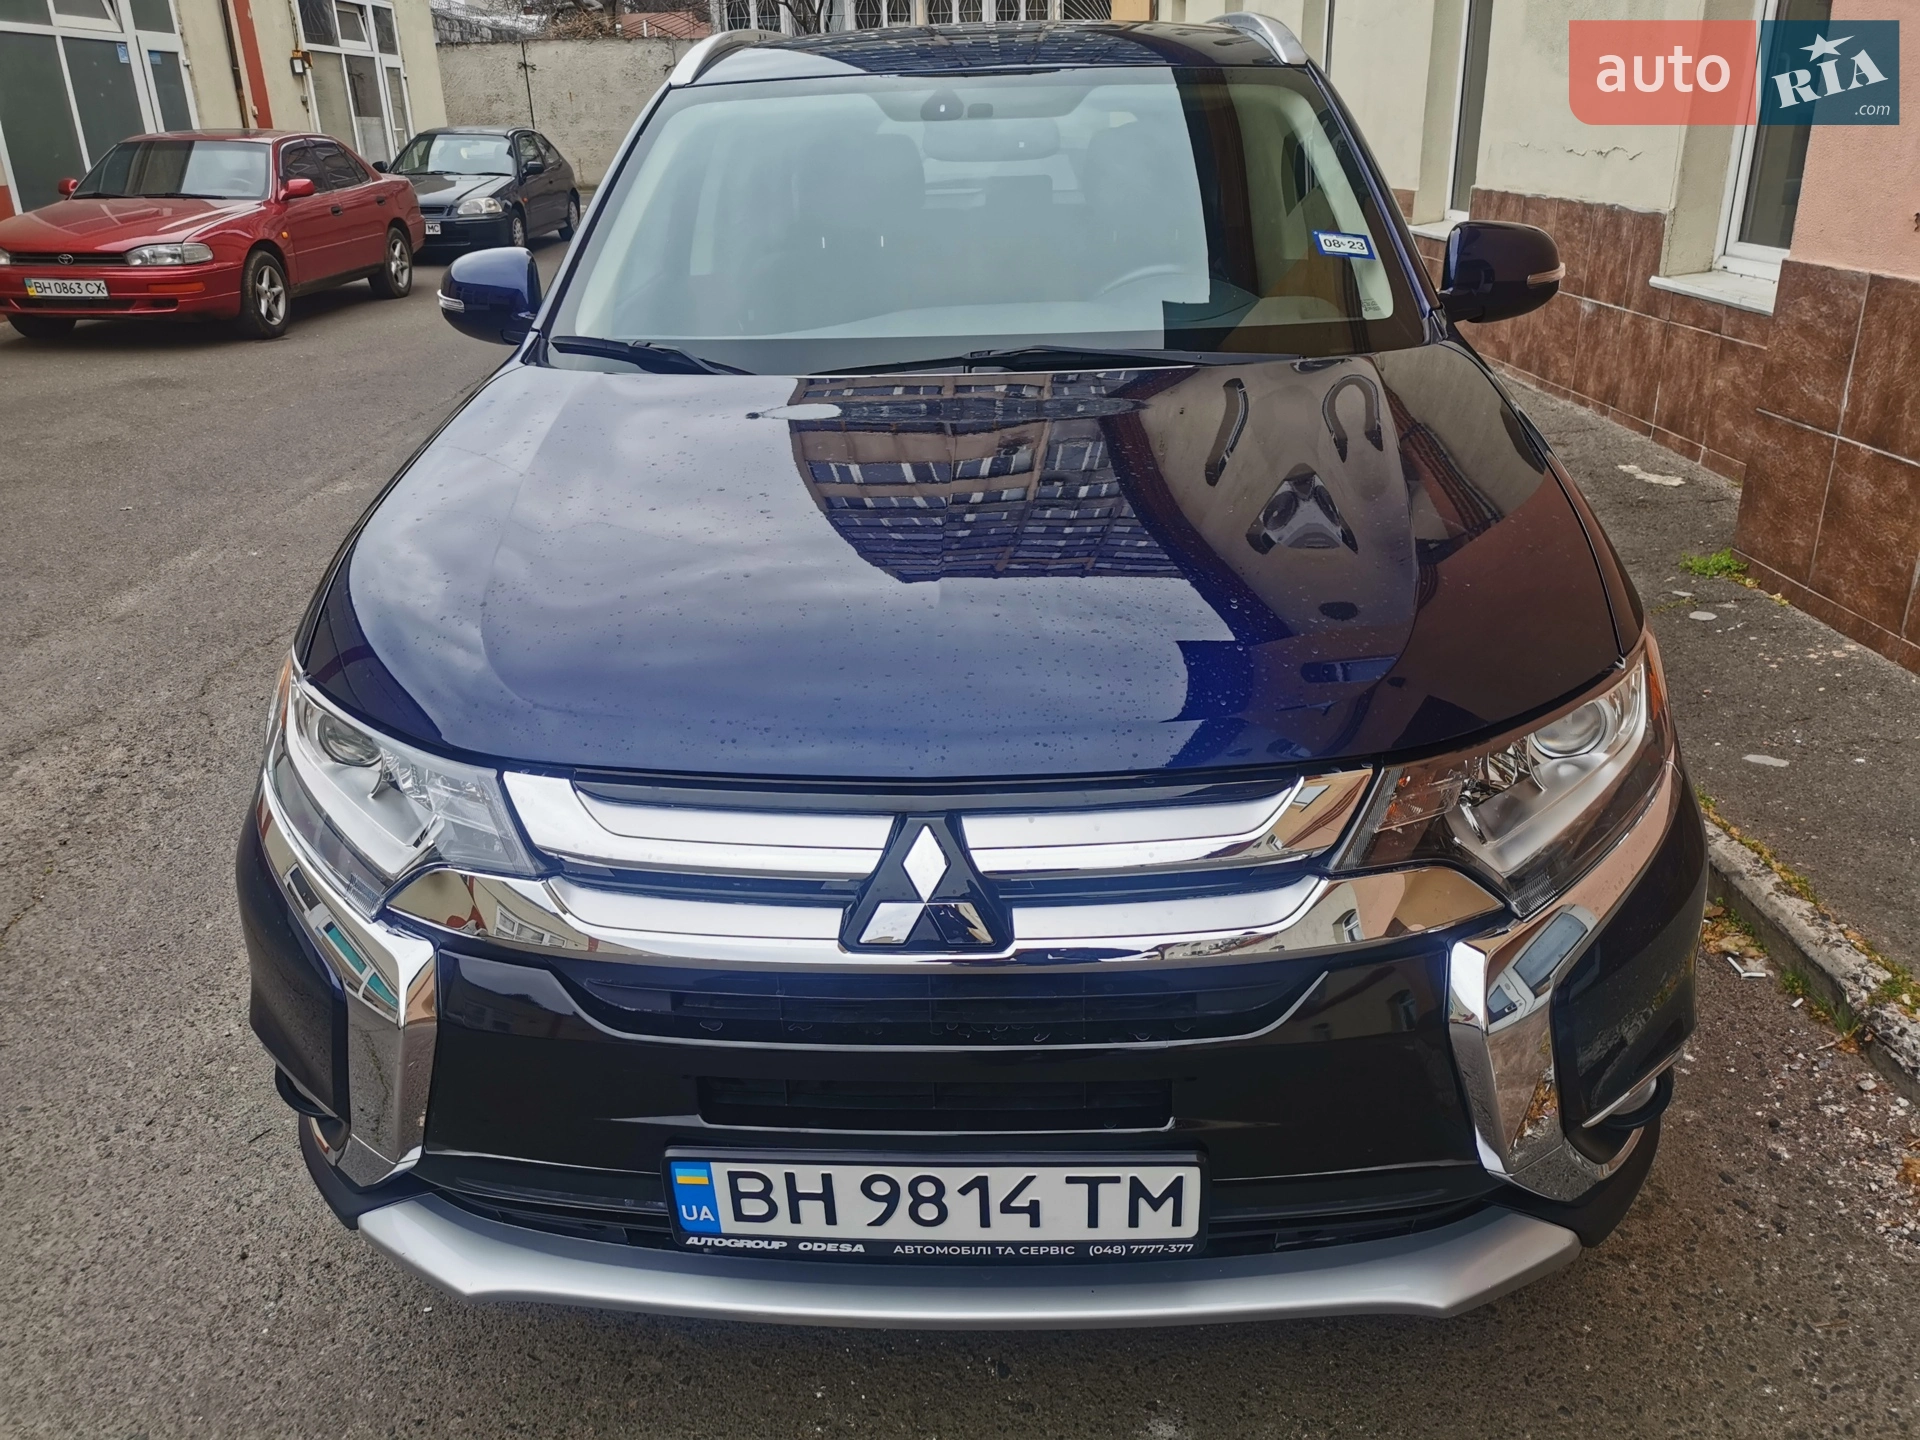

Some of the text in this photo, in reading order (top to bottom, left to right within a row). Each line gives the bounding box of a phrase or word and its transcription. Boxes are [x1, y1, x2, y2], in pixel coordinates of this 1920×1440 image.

[427, 224, 440, 233] MC
[1323, 238, 1365, 251] 08 23
[33, 281, 105, 294] BH 0863 CX
[726, 1169, 1184, 1229] BH 9814 TM
[681, 1203, 715, 1224] UA
[685, 1236, 866, 1253] AUTOGROUP ODESA
[893, 1243, 1194, 1257] АВТОМОБІЛІ ТА СЕРВІС (048) 7777-377
